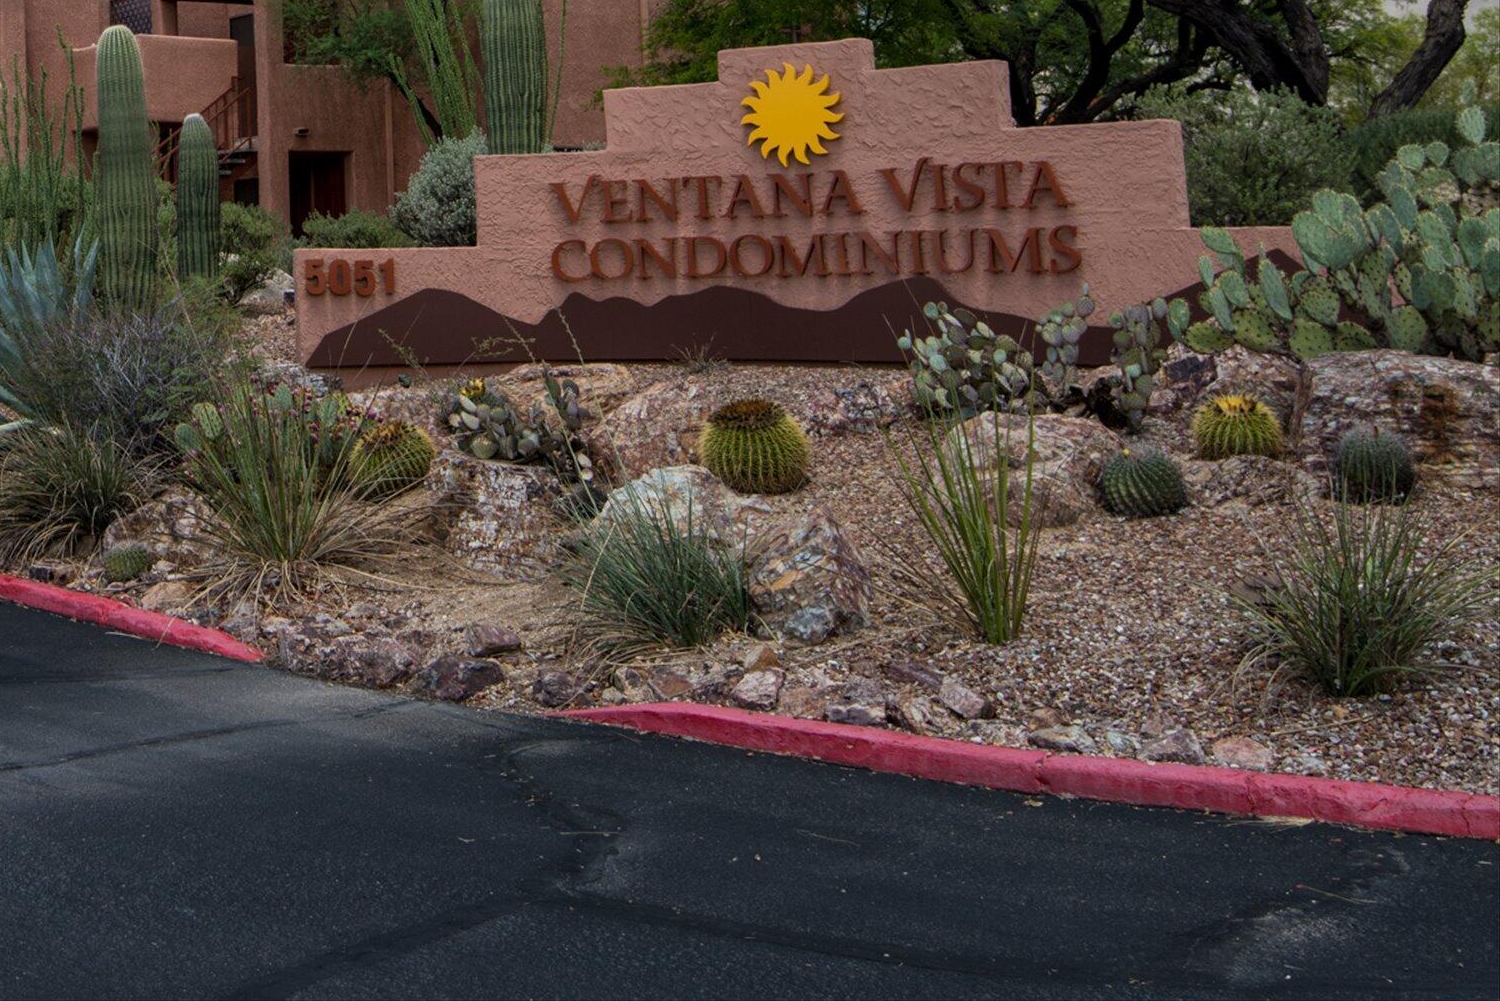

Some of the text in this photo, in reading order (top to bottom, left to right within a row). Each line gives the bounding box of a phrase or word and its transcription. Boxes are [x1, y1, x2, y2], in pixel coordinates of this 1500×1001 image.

[551, 157, 1069, 225] VENTANA VISTA
[304, 257, 397, 297] 5051
[551, 224, 1083, 282] CONDOMINIUMS
